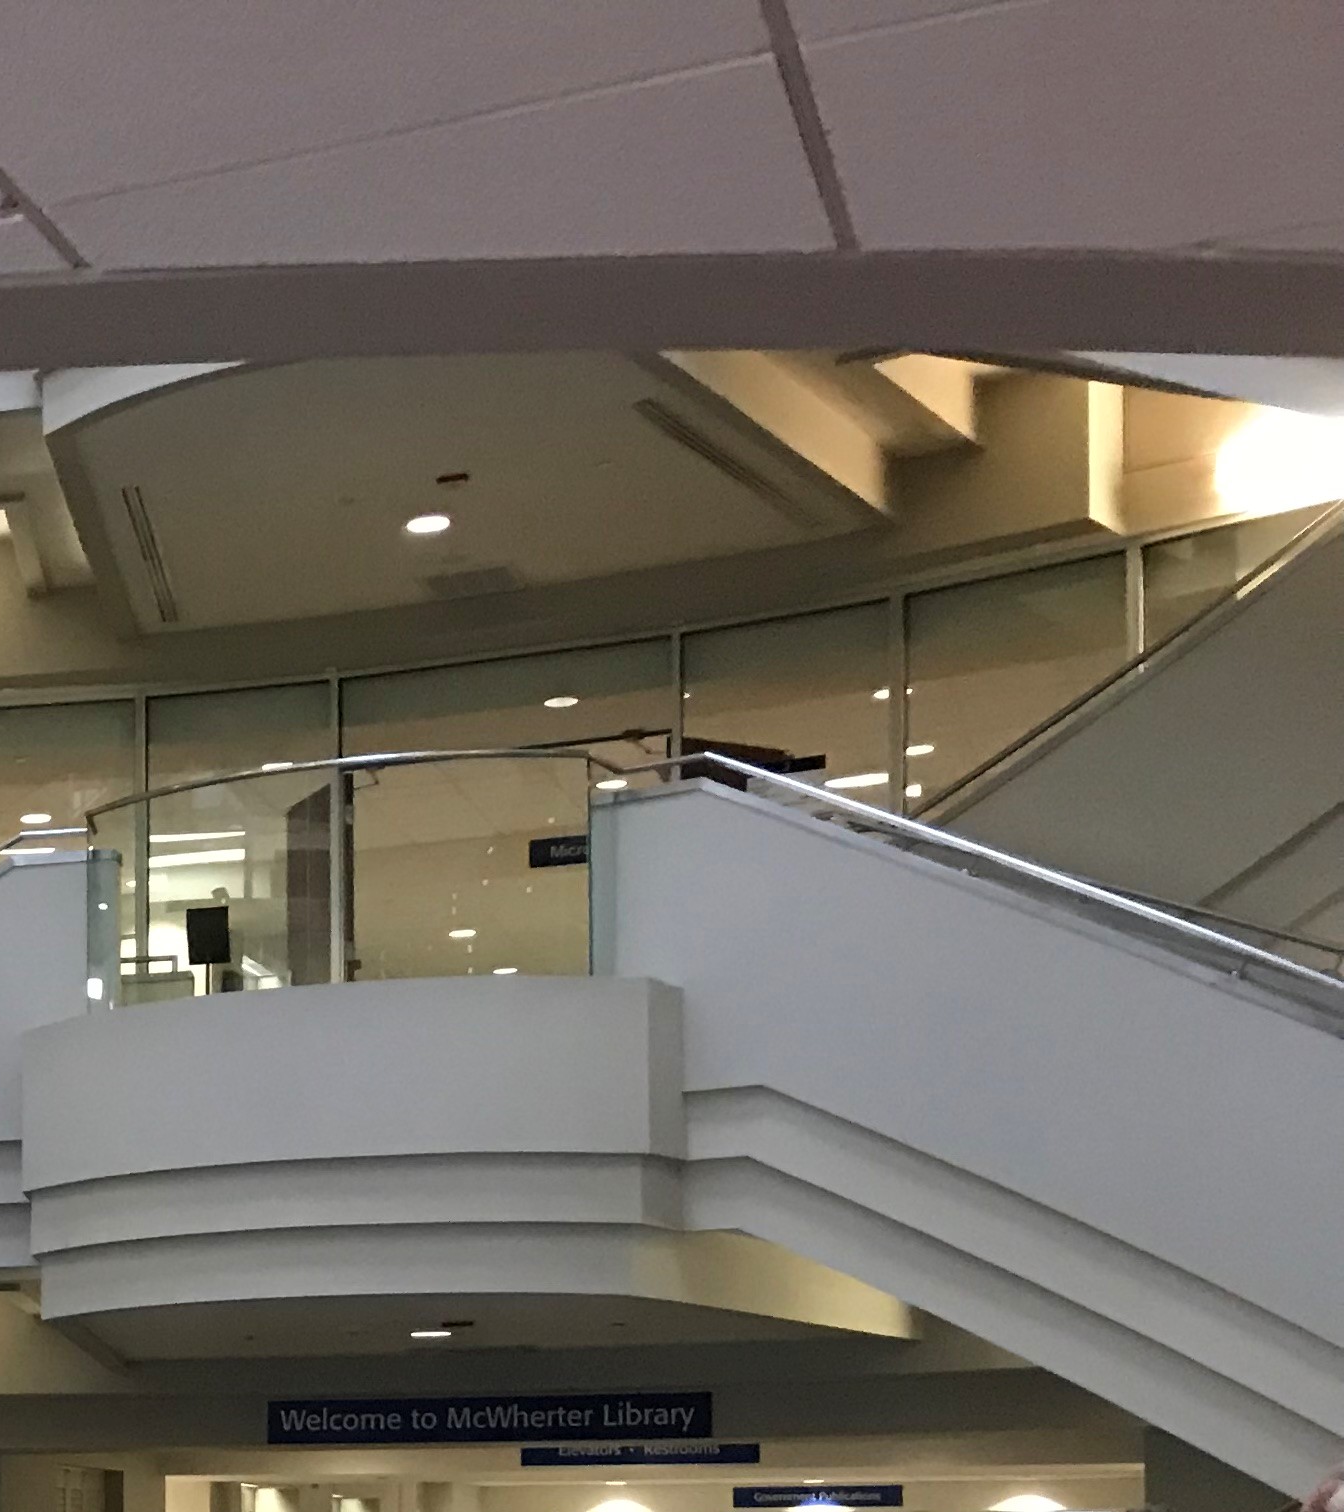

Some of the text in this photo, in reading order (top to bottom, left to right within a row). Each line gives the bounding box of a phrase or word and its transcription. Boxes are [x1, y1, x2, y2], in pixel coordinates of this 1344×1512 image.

[280, 1401, 696, 1432] Welcome to McWherter Library
